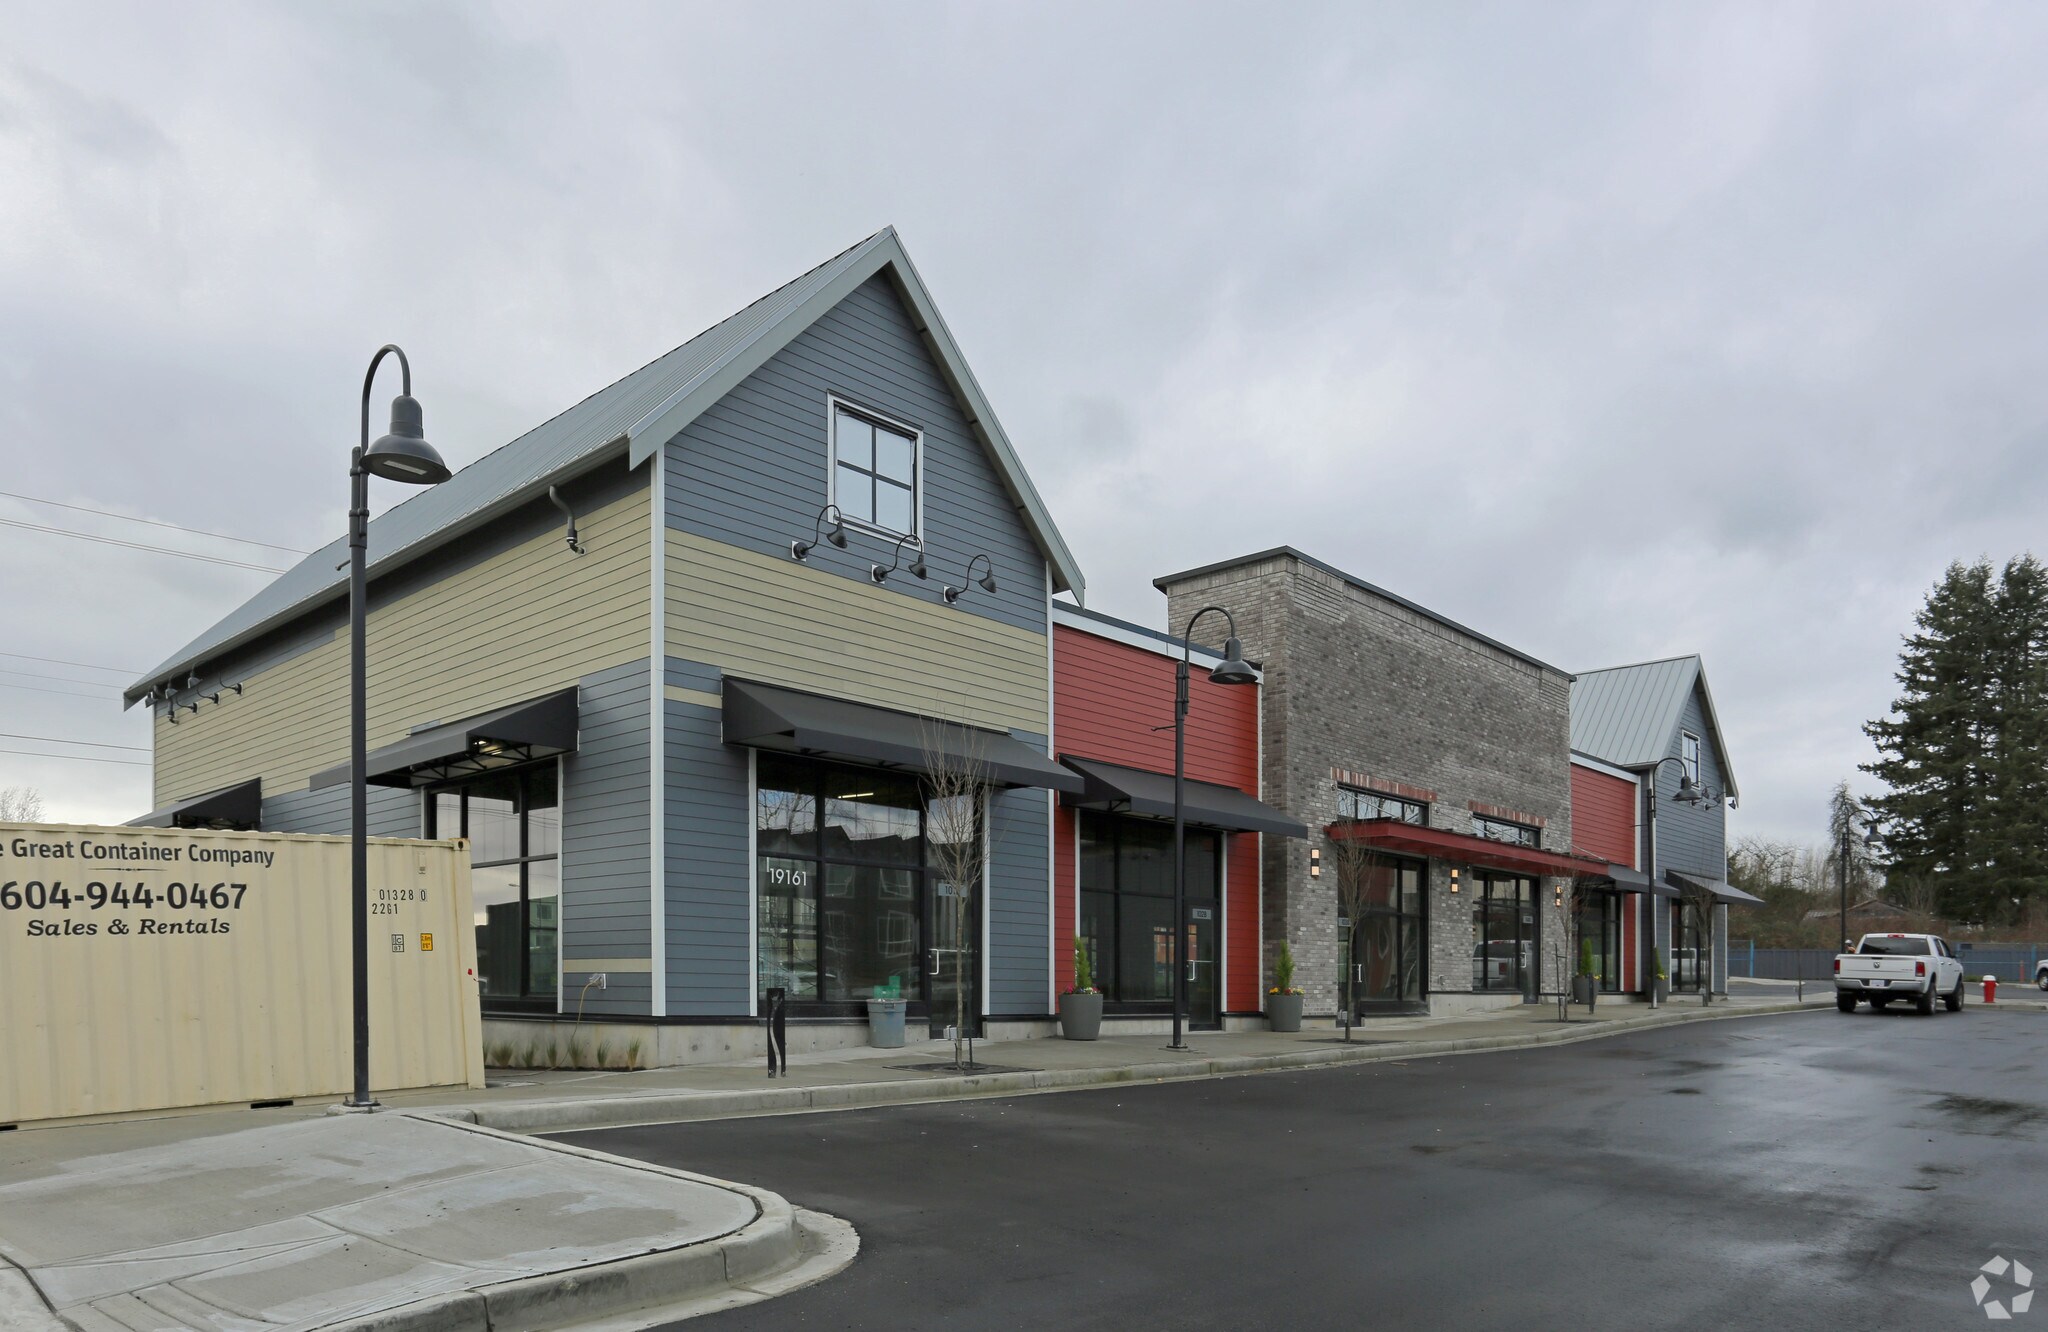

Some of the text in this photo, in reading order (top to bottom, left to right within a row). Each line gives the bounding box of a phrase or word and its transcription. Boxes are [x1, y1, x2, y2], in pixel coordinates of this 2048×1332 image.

[11, 838, 75, 858] Great
[80, 840, 182, 861] Container
[188, 844, 274, 868] Company
[770, 868, 807, 886] 19161
[0, 881, 247, 910] 604-944-0467
[379, 889, 414, 900] 01328
[27, 918, 230, 936] Sales & Rentals
